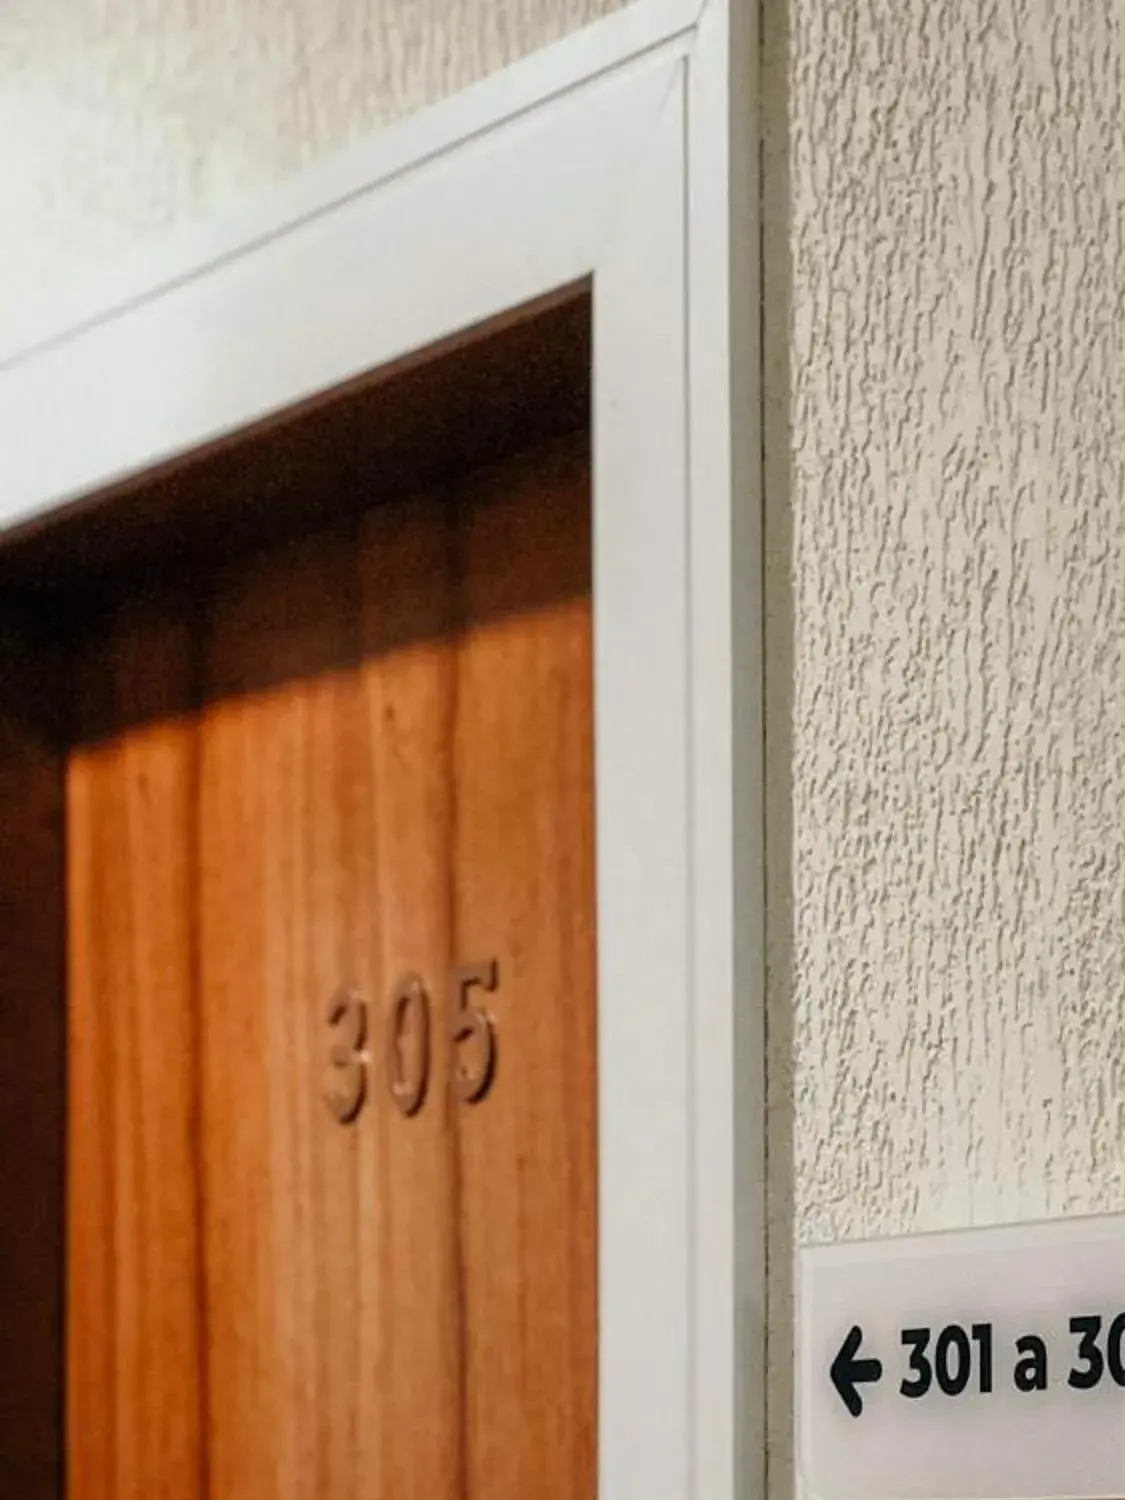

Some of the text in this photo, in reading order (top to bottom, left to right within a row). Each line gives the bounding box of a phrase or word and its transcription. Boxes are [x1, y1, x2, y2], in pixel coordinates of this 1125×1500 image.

[322, 956, 499, 1127] 305
[899, 1322, 993, 1399] 301
[1013, 1334, 1048, 1393] a
